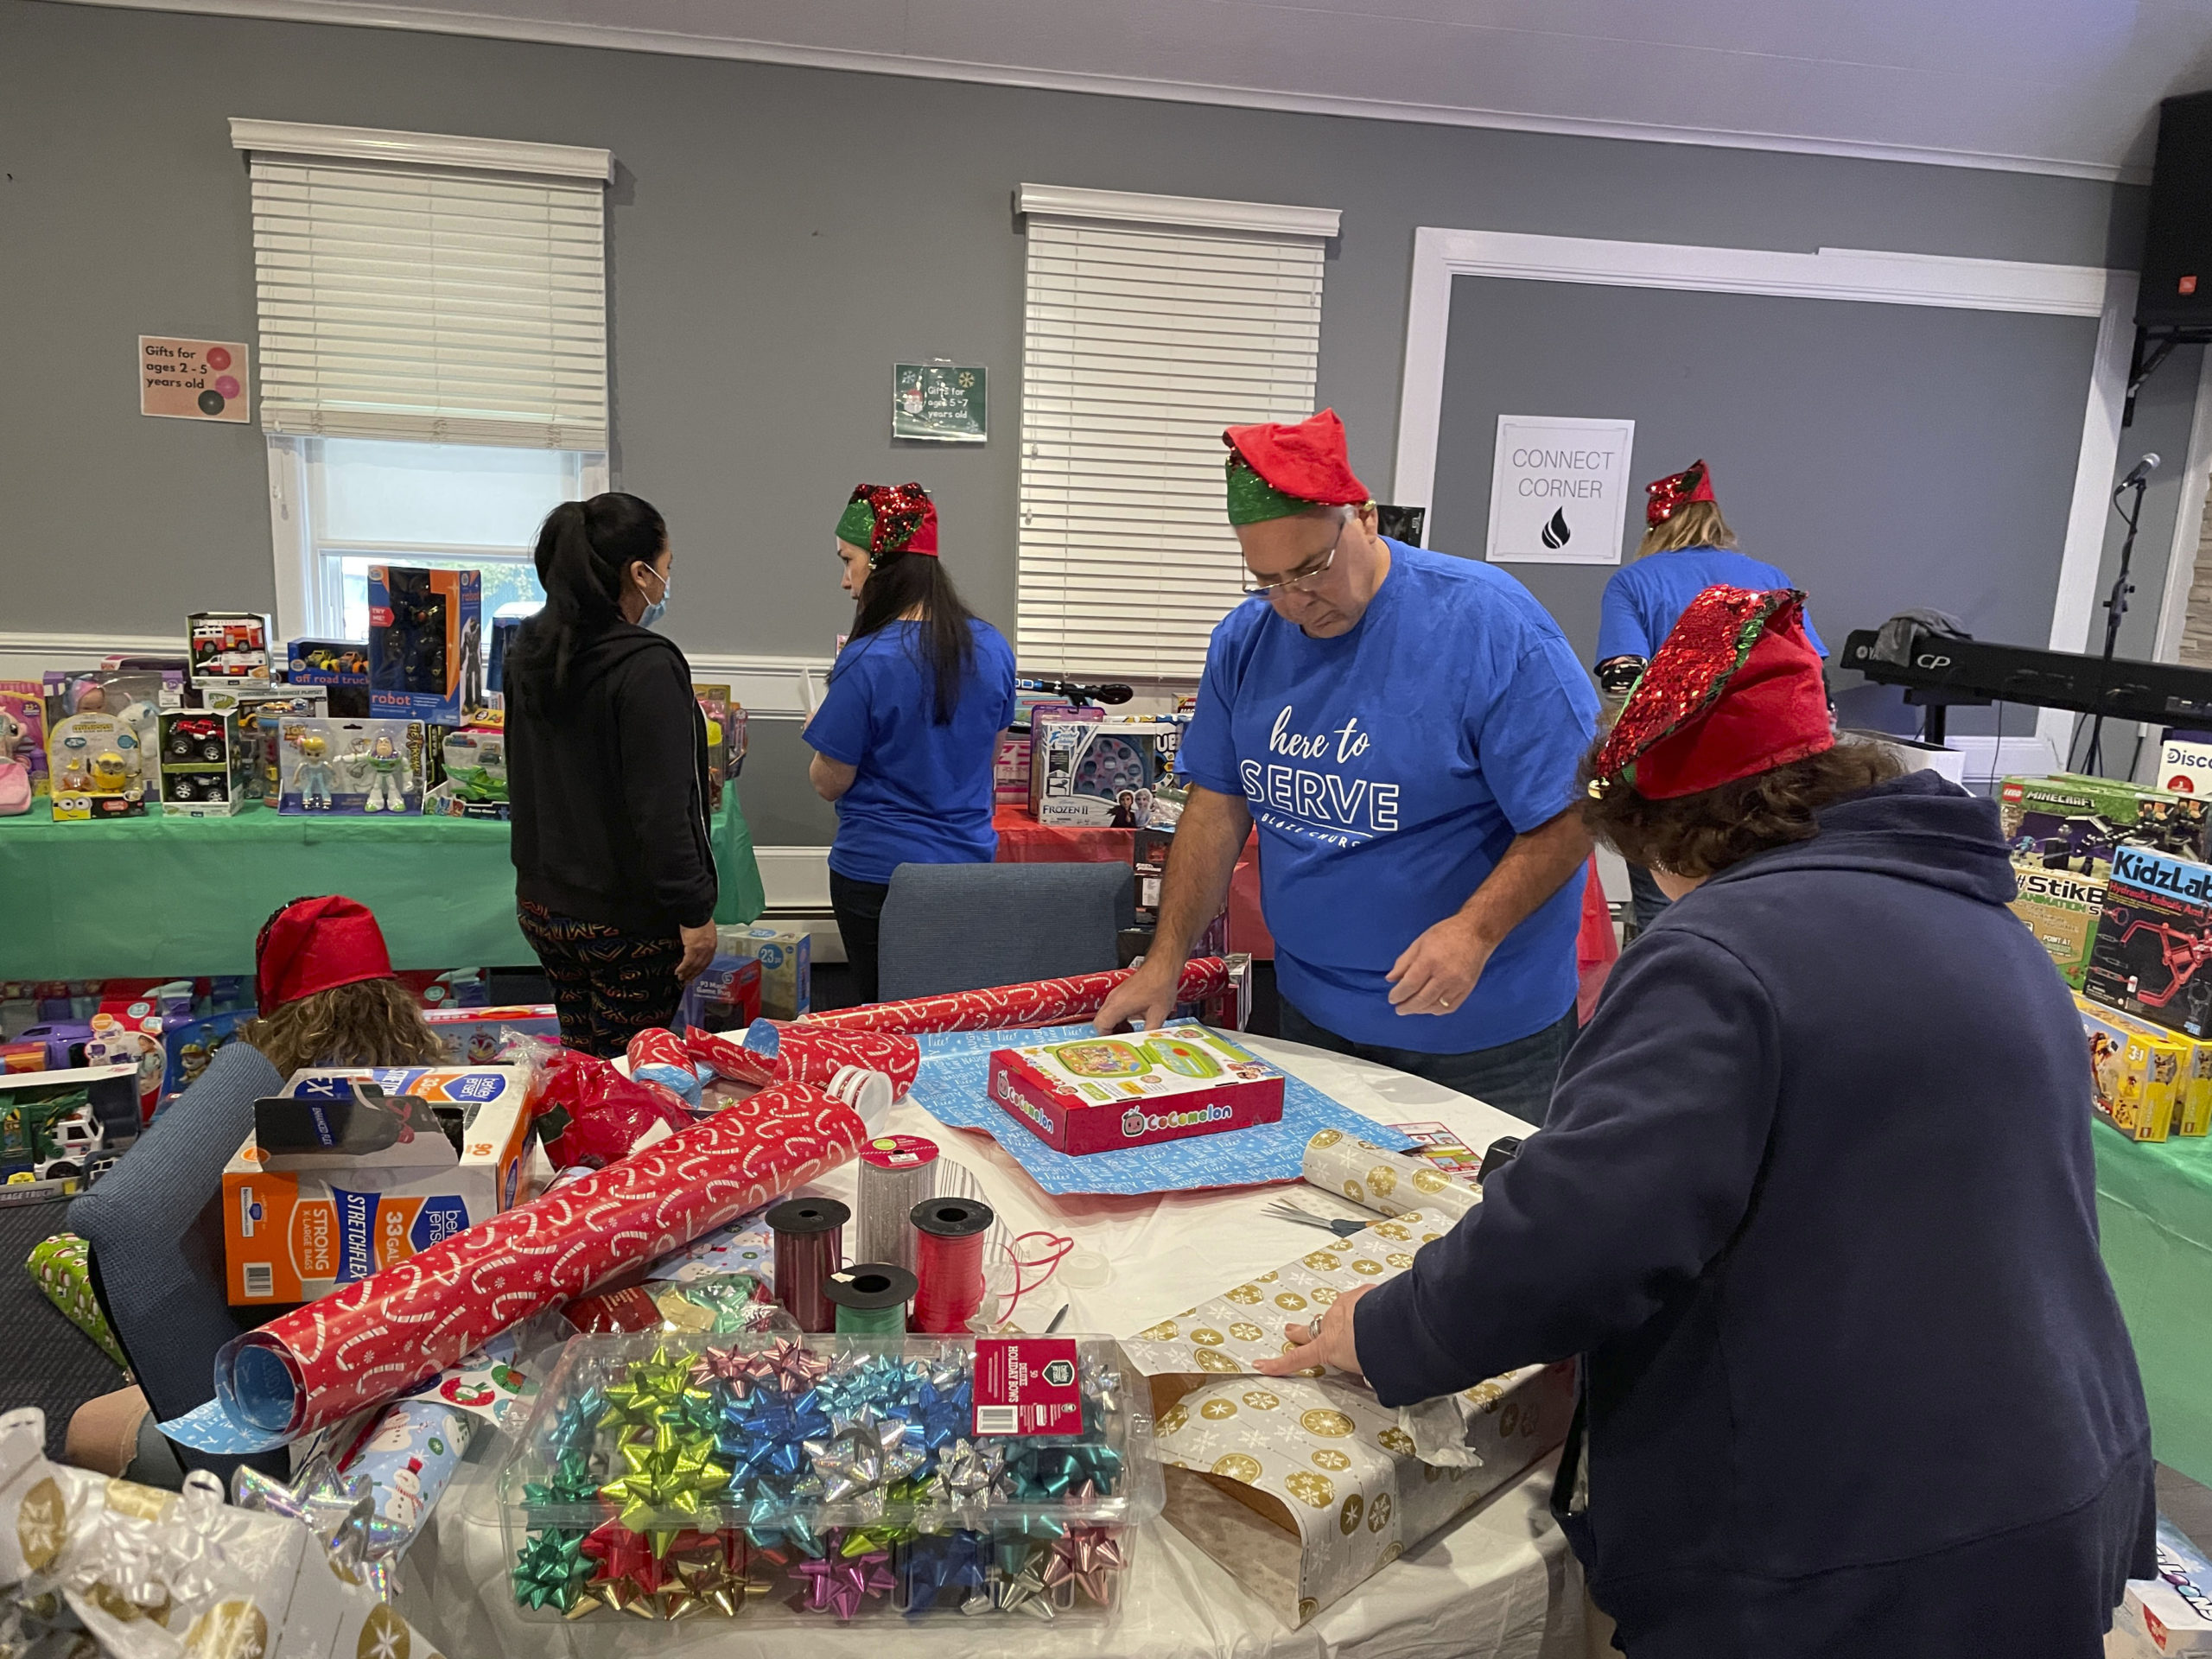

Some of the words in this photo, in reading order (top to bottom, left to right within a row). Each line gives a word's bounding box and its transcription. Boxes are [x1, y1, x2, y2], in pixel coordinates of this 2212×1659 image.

[145, 346, 174, 357] Gifts
[177, 347, 196, 359] for
[146, 363, 175, 374] ages
[180, 363, 188, 373] 2
[200, 365, 207, 374] 5
[146, 378, 181, 388] years
[185, 378, 205, 389] old
[927, 385, 950, 396] Gifts
[951, 387, 966, 396] for
[927, 410, 953, 419] years
[954, 410, 968, 419] old
[1513, 448, 1615, 470] CONNECT
[1518, 478, 1603, 499] CORNER
[1916, 653, 1951, 670] CP
[295, 673, 311, 684] off
[313, 674, 340, 684] road
[372, 693, 411, 707] robot
[1269, 705, 1330, 760] here
[1333, 717, 1371, 764] to
[1240, 759, 1399, 832] SERVE
[2026, 791, 2095, 808] MINECRAFT
[1043, 804, 1080, 815] FROZEN
[2183, 904, 2205, 918] Arm
[760, 948, 774, 963] 23
[460, 1077, 479, 1096] jensen
[480, 1077, 499, 1099] berkley
[312, 1107, 328, 1134] ENHANCED
[321, 1134, 333, 1147] FLEX
[302, 1211, 313, 1247] X-LARGE
[385, 1211, 404, 1236] 33
[313, 1208, 329, 1271] STRONG
[347, 1194, 368, 1280] STRETCHFLEX
[302, 1248, 313, 1271] BAGS
[386, 1236, 400, 1262] GAL
[1007, 1345, 1019, 1380] HOLIDAY
[1007, 1380, 1019, 1403] BOWS
